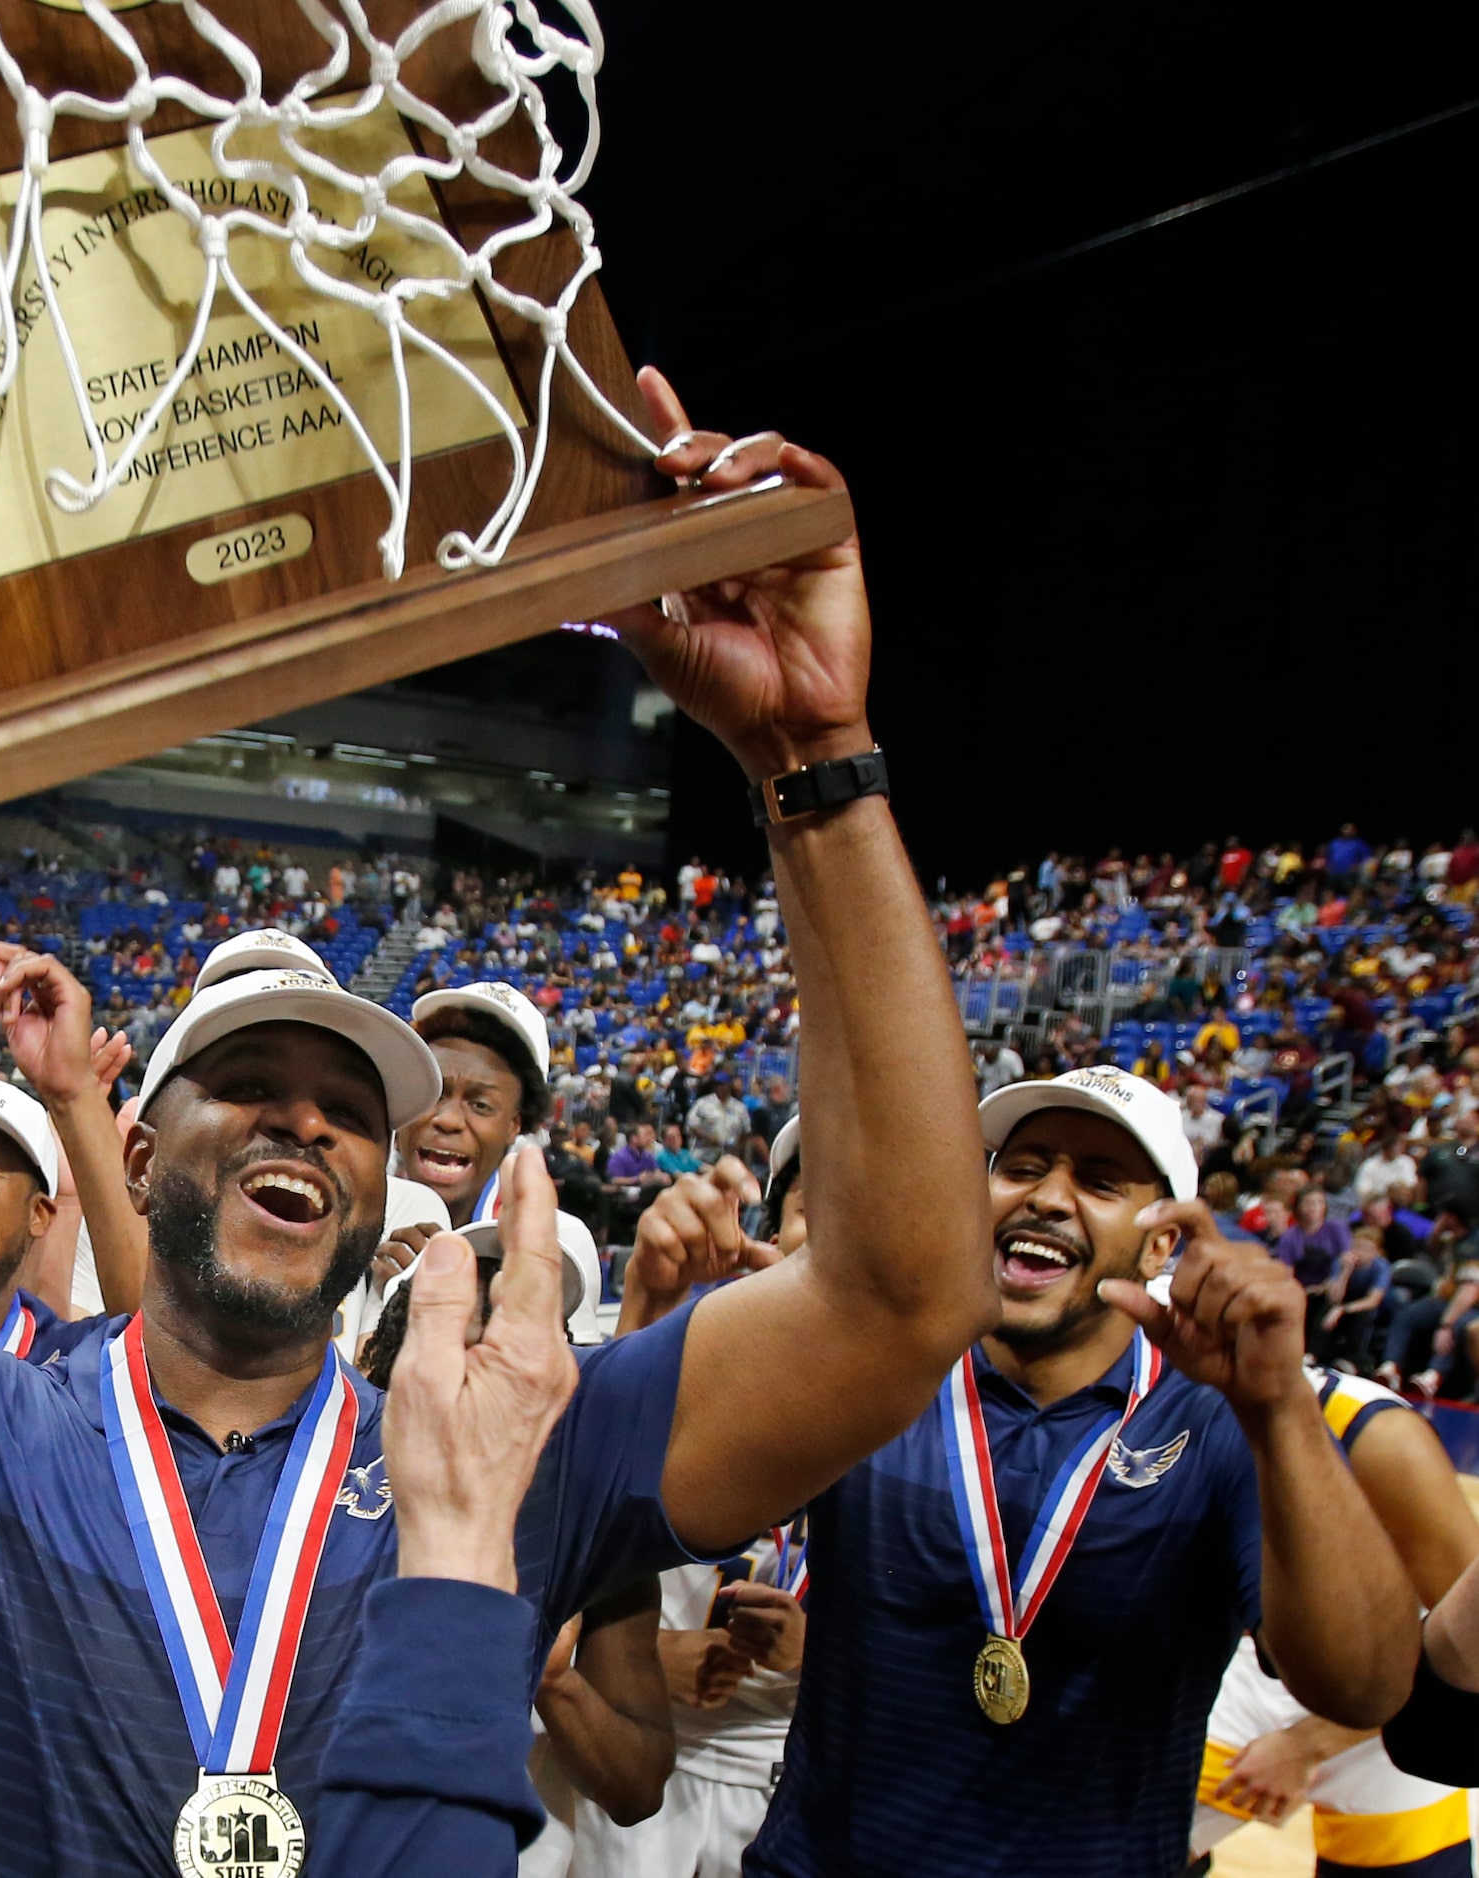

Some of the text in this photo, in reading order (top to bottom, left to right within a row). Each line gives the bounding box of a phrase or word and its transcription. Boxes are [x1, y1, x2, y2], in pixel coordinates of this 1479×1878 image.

[74, 177, 323, 257] INTERSHOLAST
[86, 360, 169, 403] STATE
[216, 525, 286, 570] 2023
[199, 1814, 279, 1863] UIL
[214, 1865, 266, 1878] STATE
